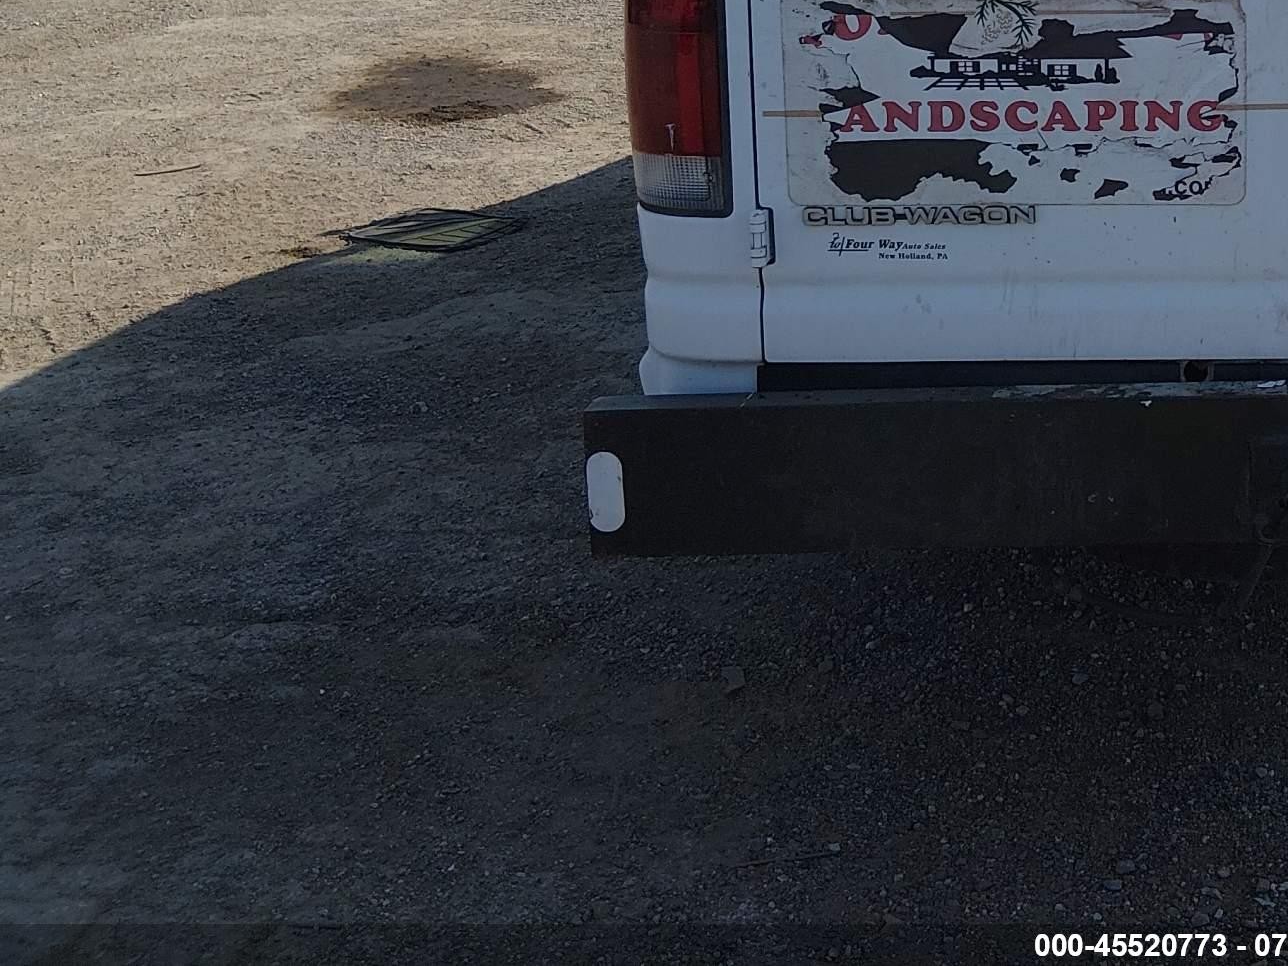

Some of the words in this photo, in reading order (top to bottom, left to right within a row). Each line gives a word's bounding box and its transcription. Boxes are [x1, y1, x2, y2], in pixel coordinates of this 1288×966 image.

[840, 100, 1224, 132] ANDSCAPING
[803, 205, 1037, 226] CLUB-WAGON
[846, 239, 875, 249] Four
[879, 239, 904, 251] Way
[902, 242, 922, 250] Auto
[924, 242, 946, 250] Sales
[898, 253, 935, 261] Holland,
